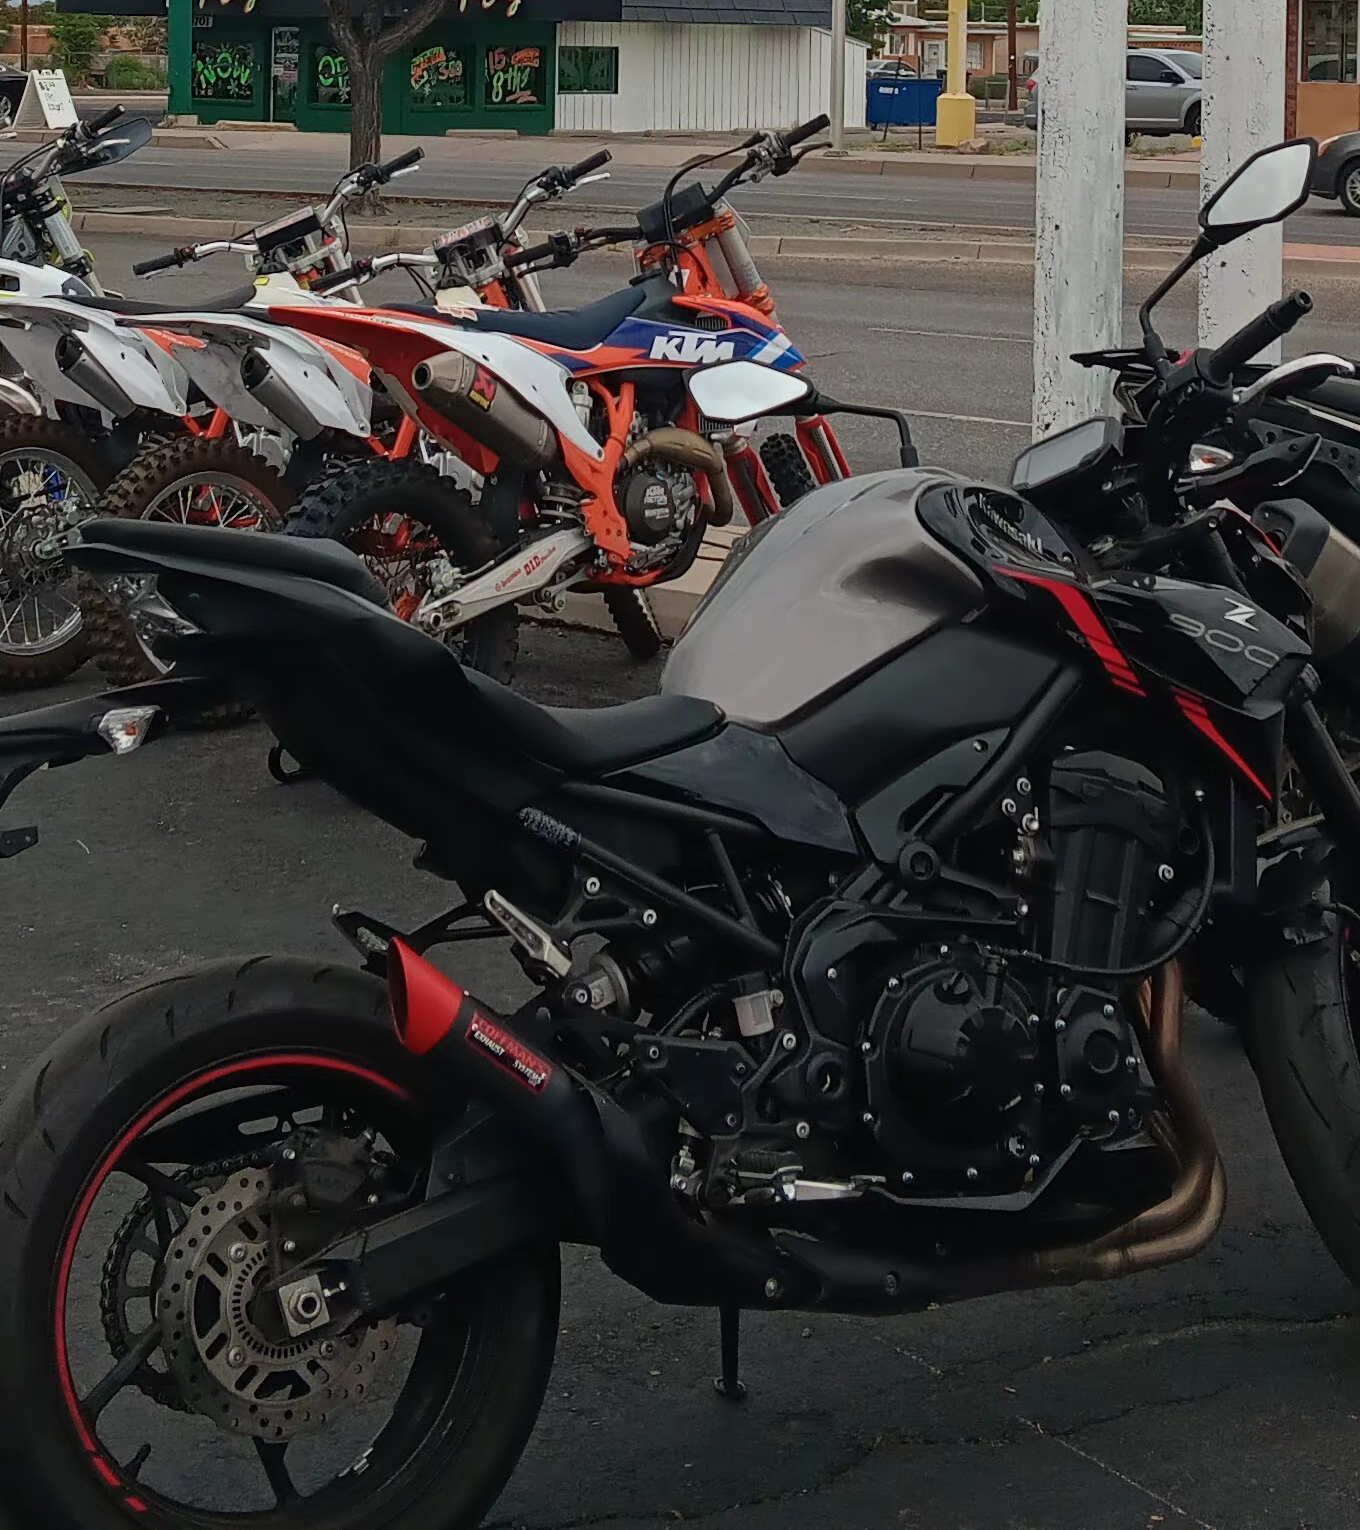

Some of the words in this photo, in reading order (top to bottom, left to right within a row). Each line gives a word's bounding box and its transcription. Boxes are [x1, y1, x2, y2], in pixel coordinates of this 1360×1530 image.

[192, 16, 211, 27] 701
[649, 330, 735, 364] KTM
[1168, 613, 1280, 669] 900
